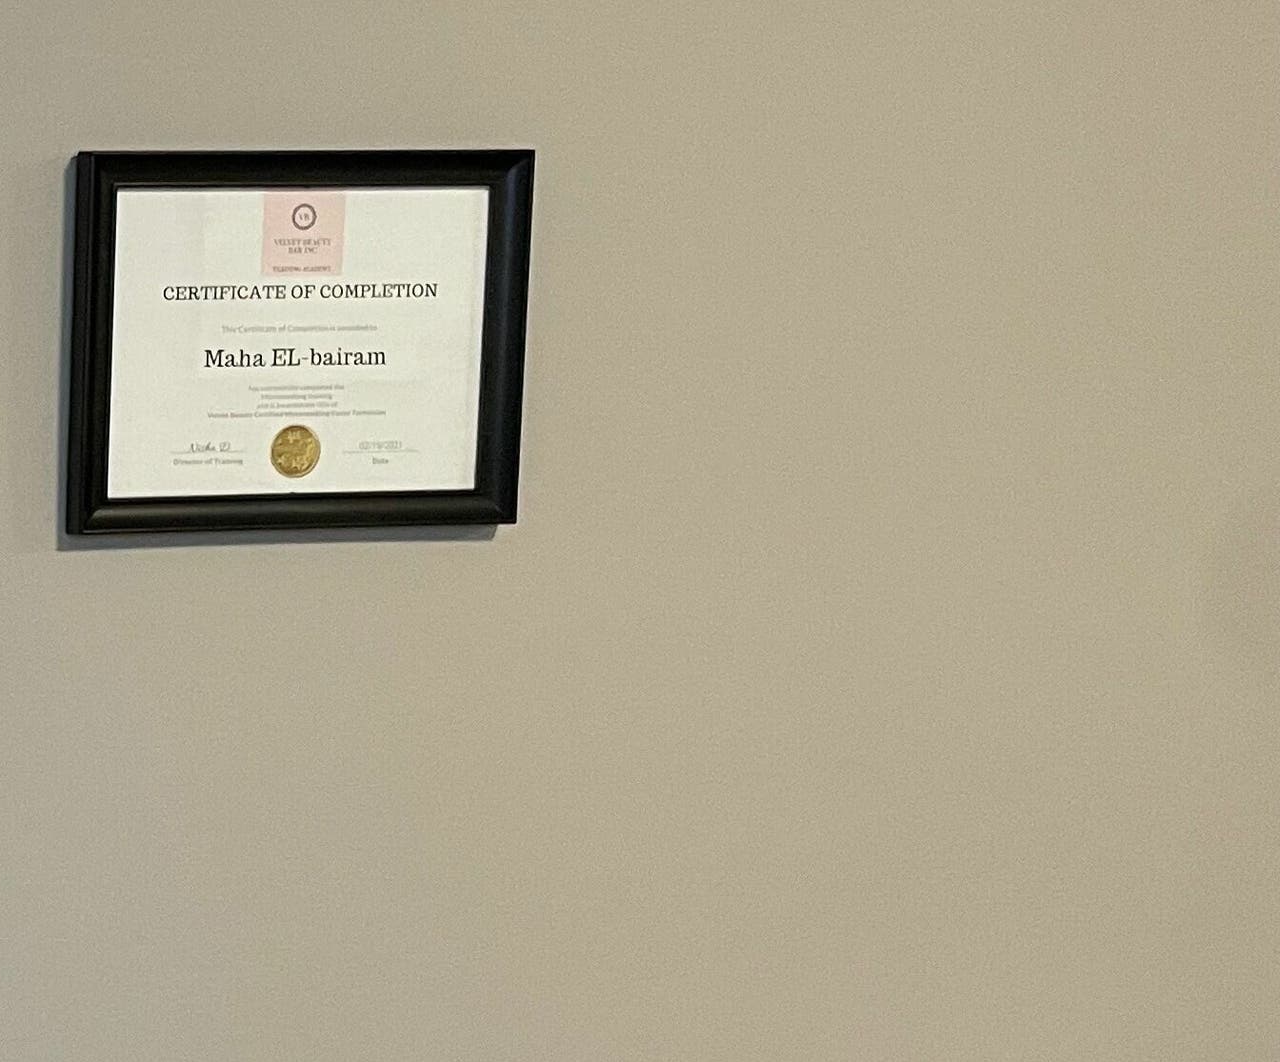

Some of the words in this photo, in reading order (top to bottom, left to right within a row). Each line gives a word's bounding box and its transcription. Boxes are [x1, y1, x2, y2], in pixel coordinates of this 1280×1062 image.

[162, 285, 287, 301] CERTIFICATE
[290, 284, 316, 300] OF
[320, 283, 438, 299] COMPLETION
[203, 349, 266, 367] Maha
[271, 347, 386, 367] EL-bairam
